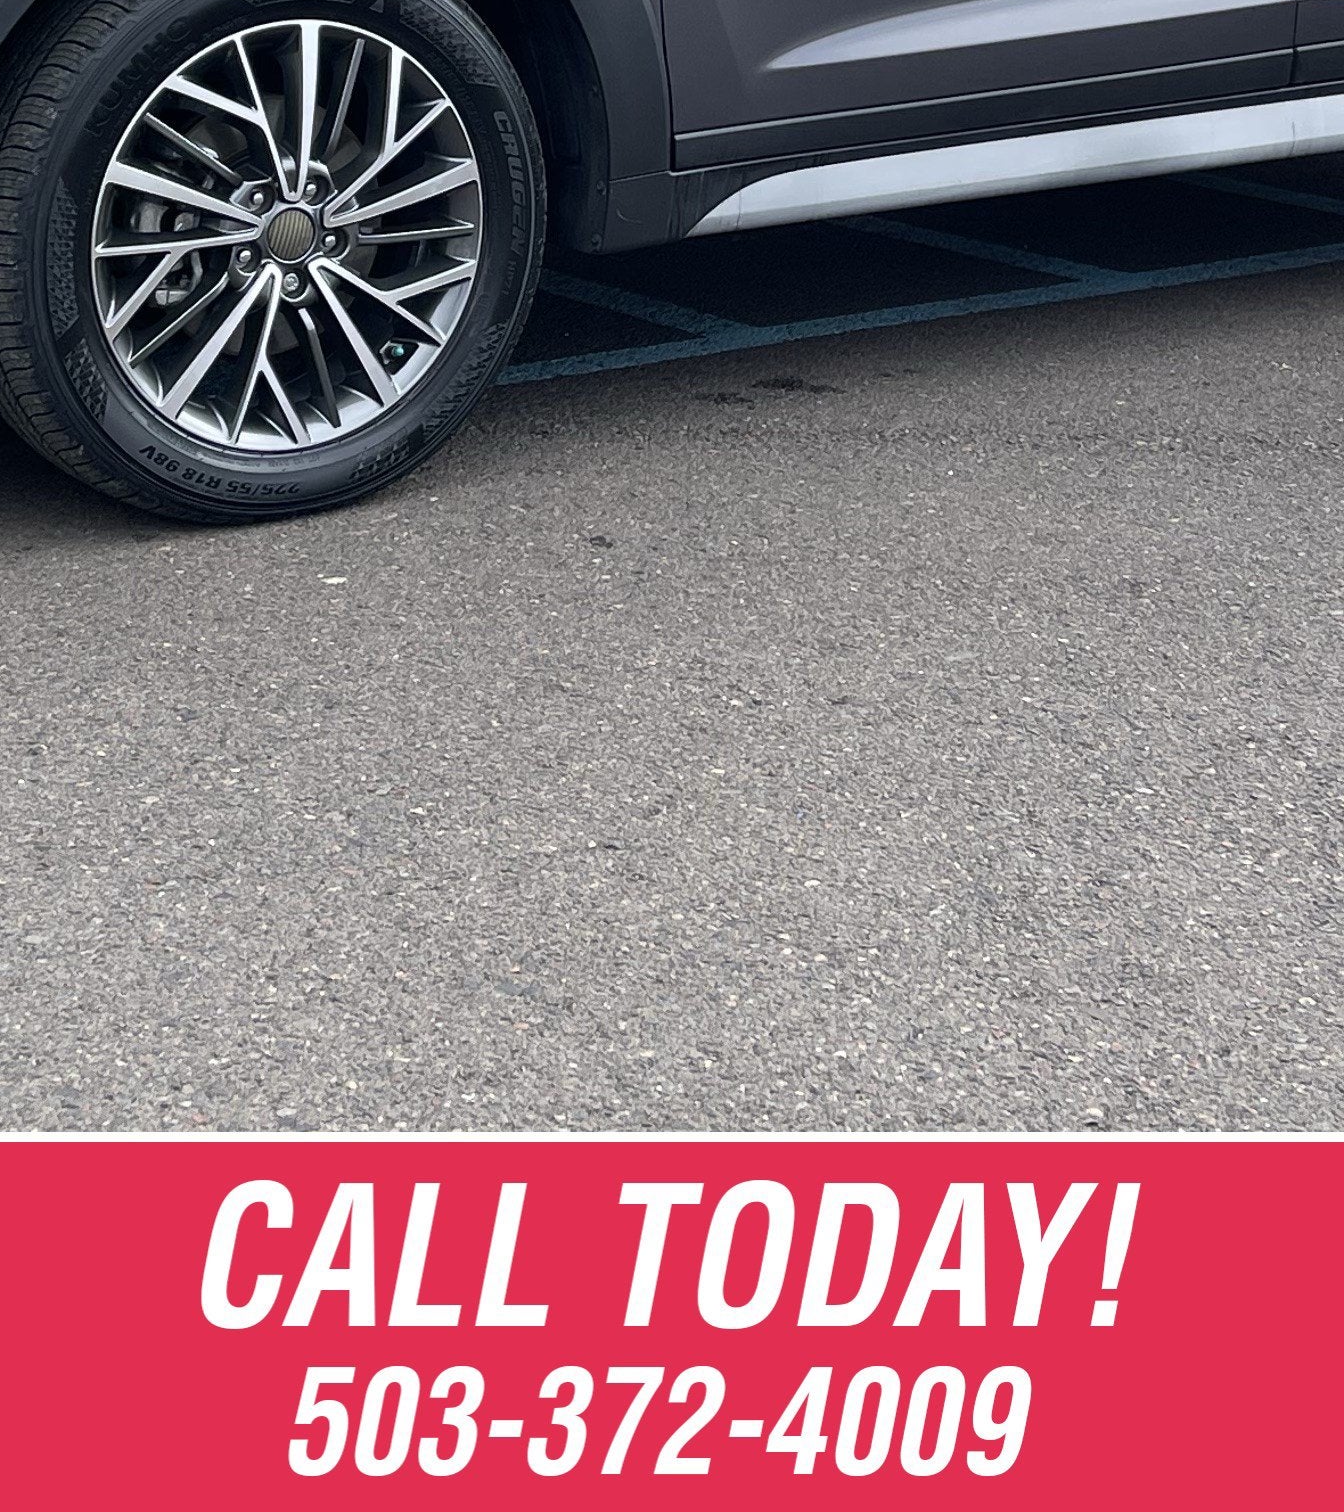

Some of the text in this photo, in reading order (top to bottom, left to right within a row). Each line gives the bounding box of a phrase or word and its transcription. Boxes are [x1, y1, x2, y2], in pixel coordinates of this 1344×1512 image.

[493, 110, 527, 257] CRUGEN
[139, 444, 181, 473] 98V
[181, 467, 222, 490] R18
[226, 480, 301, 496] 225/55
